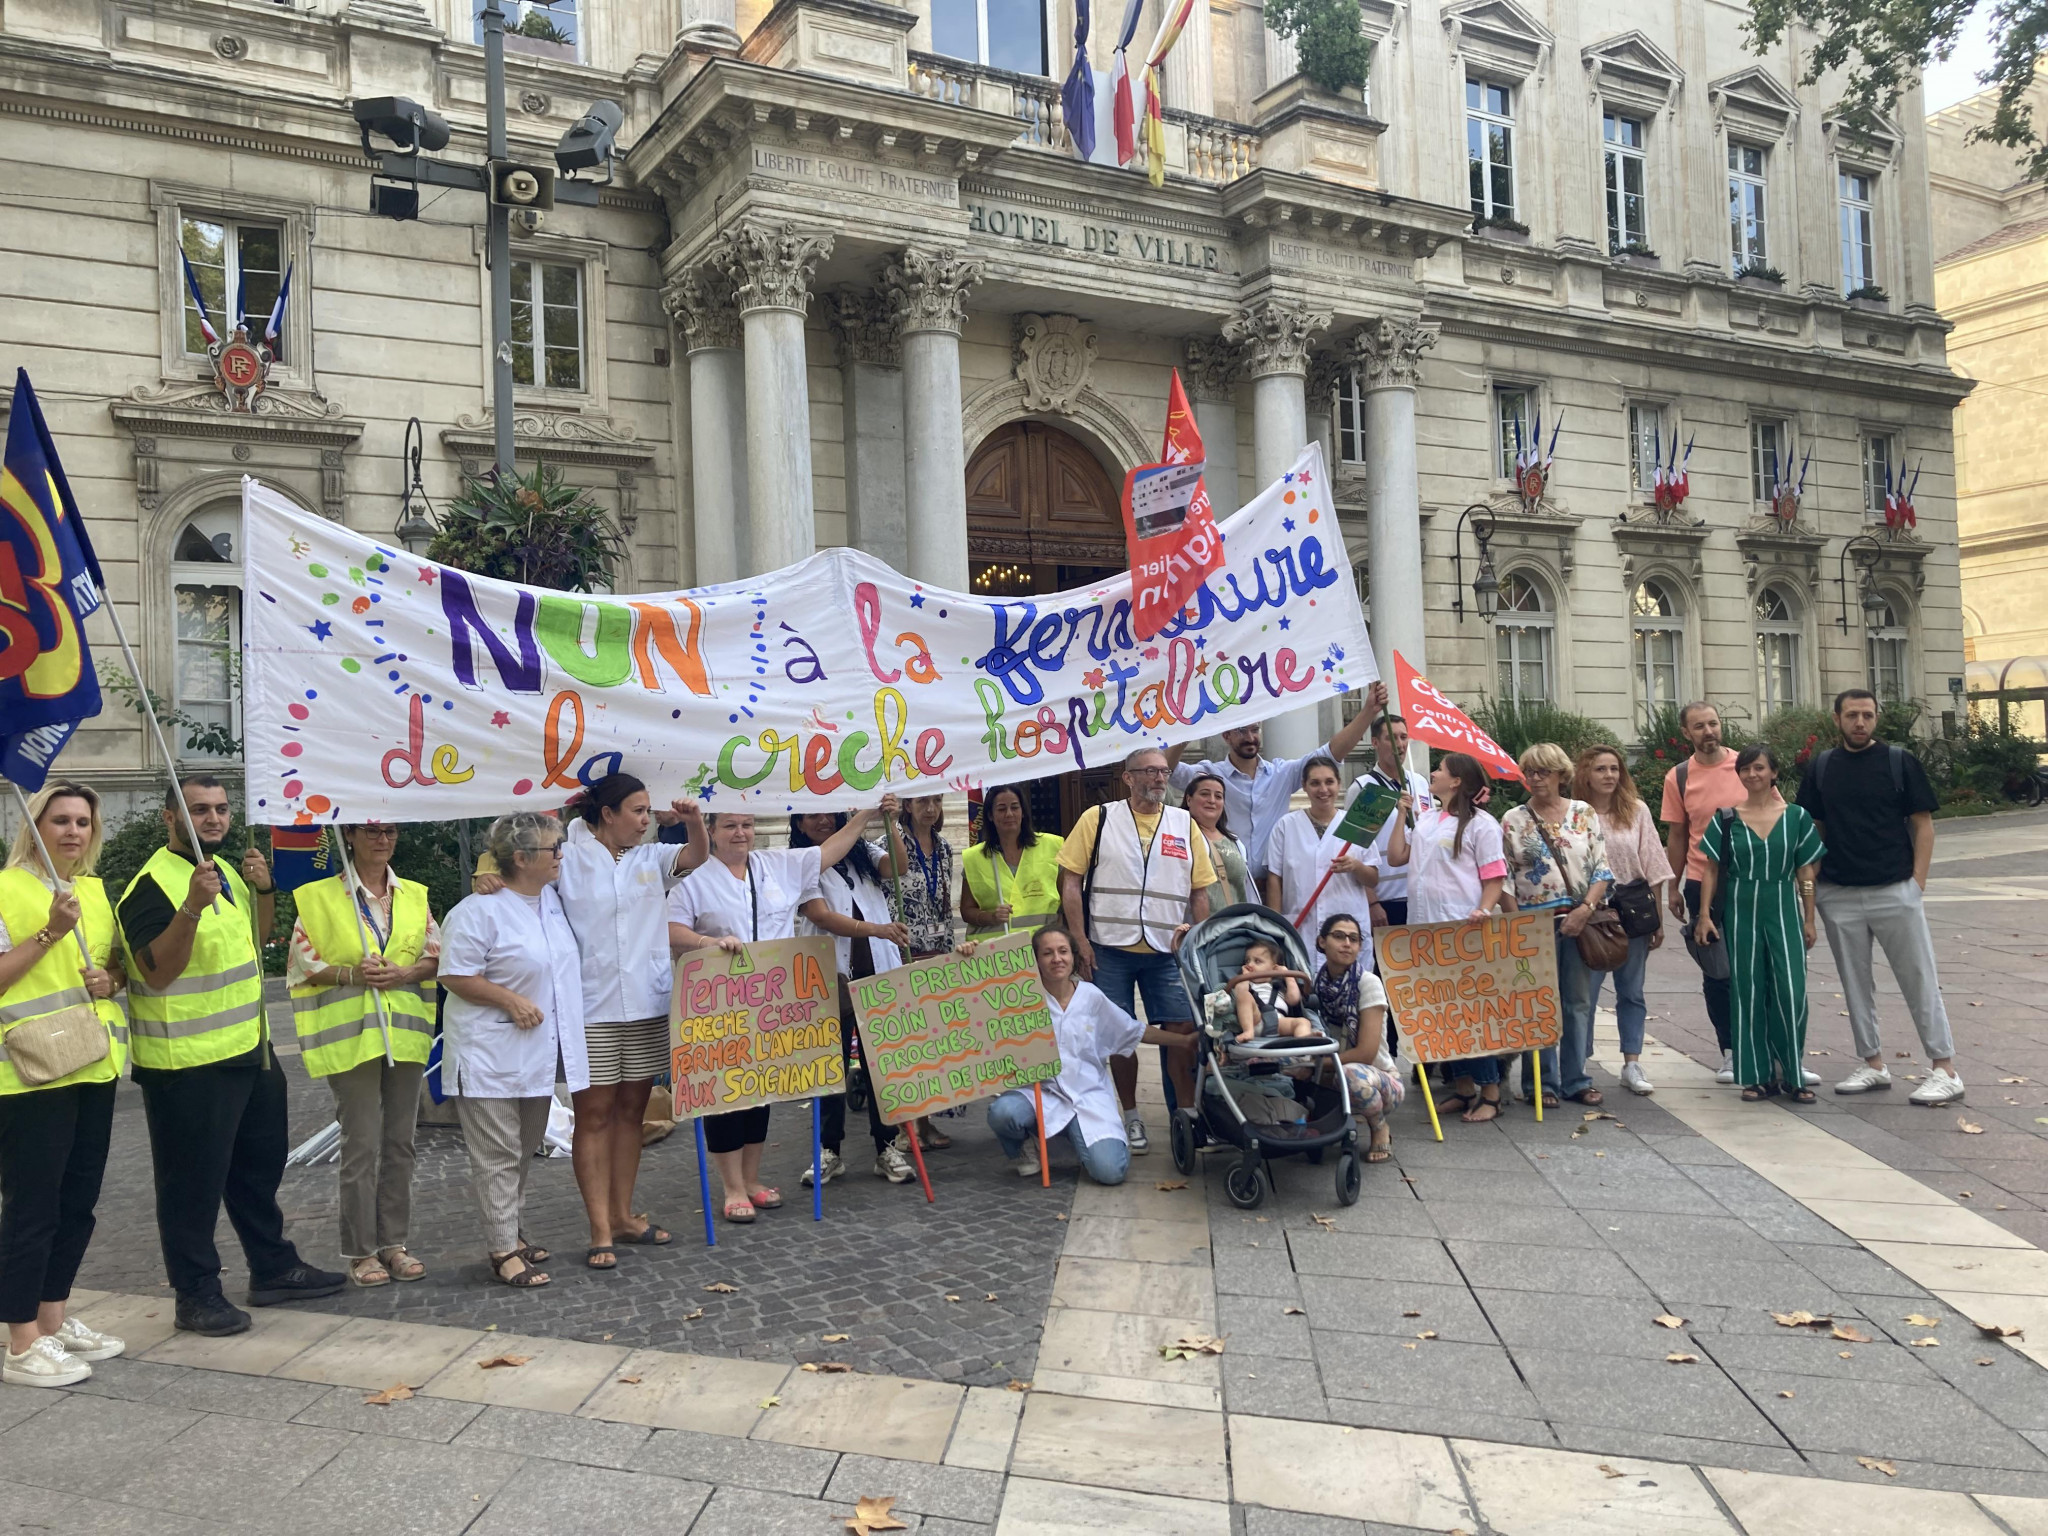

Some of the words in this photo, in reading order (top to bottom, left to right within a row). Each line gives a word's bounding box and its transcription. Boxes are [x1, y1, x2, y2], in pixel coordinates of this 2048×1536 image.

[755, 149, 812, 175] LIBERTE
[818, 160, 873, 186] EGALITE
[880, 171, 957, 200] FRATERNITE
[968, 204, 1068, 246] HOTEL
[1083, 225, 1119, 255] DE
[1134, 233, 1219, 270] VILLE
[779, 621, 828, 684] à
[854, 582, 943, 685] la
[381, 693, 475, 788] de
[541, 690, 623, 789] la
[1412, 703, 1468, 728] Centre
[1381, 915, 1540, 971] CRECHE
[793, 953, 829, 1000] LA
[859, 978, 897, 1010] ILS
[909, 944, 1035, 997] PRENNENT
[938, 998, 970, 1025] DE
[982, 979, 1042, 1010] VOS
[680, 1009, 750, 1044] CRECHE
[757, 1001, 818, 1032] C'EST
[878, 1026, 984, 1076] PROCHES,
[986, 1007, 1053, 1041] PRENEZ
[948, 1065, 974, 1090] DE
[976, 1054, 1018, 1082] LEUR
[1002, 1059, 1062, 1089] CRECHE
